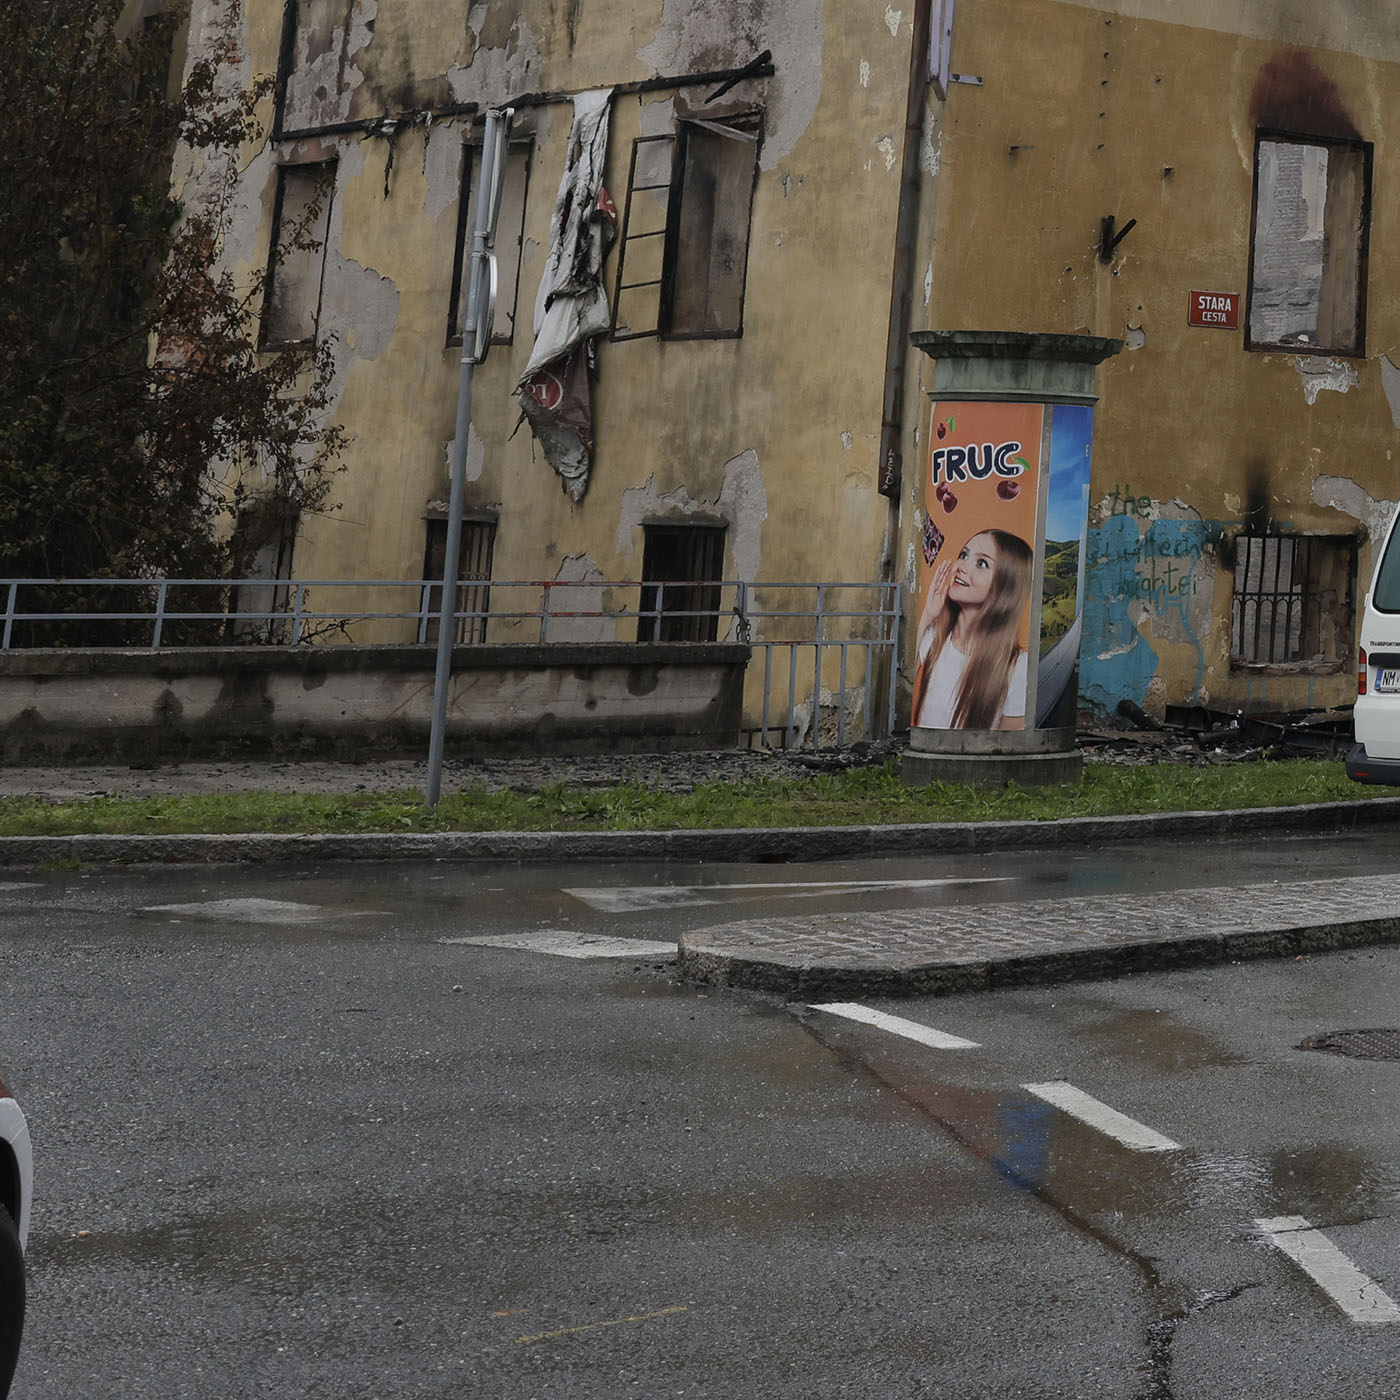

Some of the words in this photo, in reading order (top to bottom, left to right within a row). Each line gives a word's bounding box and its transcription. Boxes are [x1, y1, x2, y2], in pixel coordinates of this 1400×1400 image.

[1198, 296, 1232, 311] STARA
[1202, 311, 1227, 323] CESTA
[932, 441, 1024, 485] FRUC
[1108, 484, 1151, 517] the
[1382, 671, 1396, 686] NM
